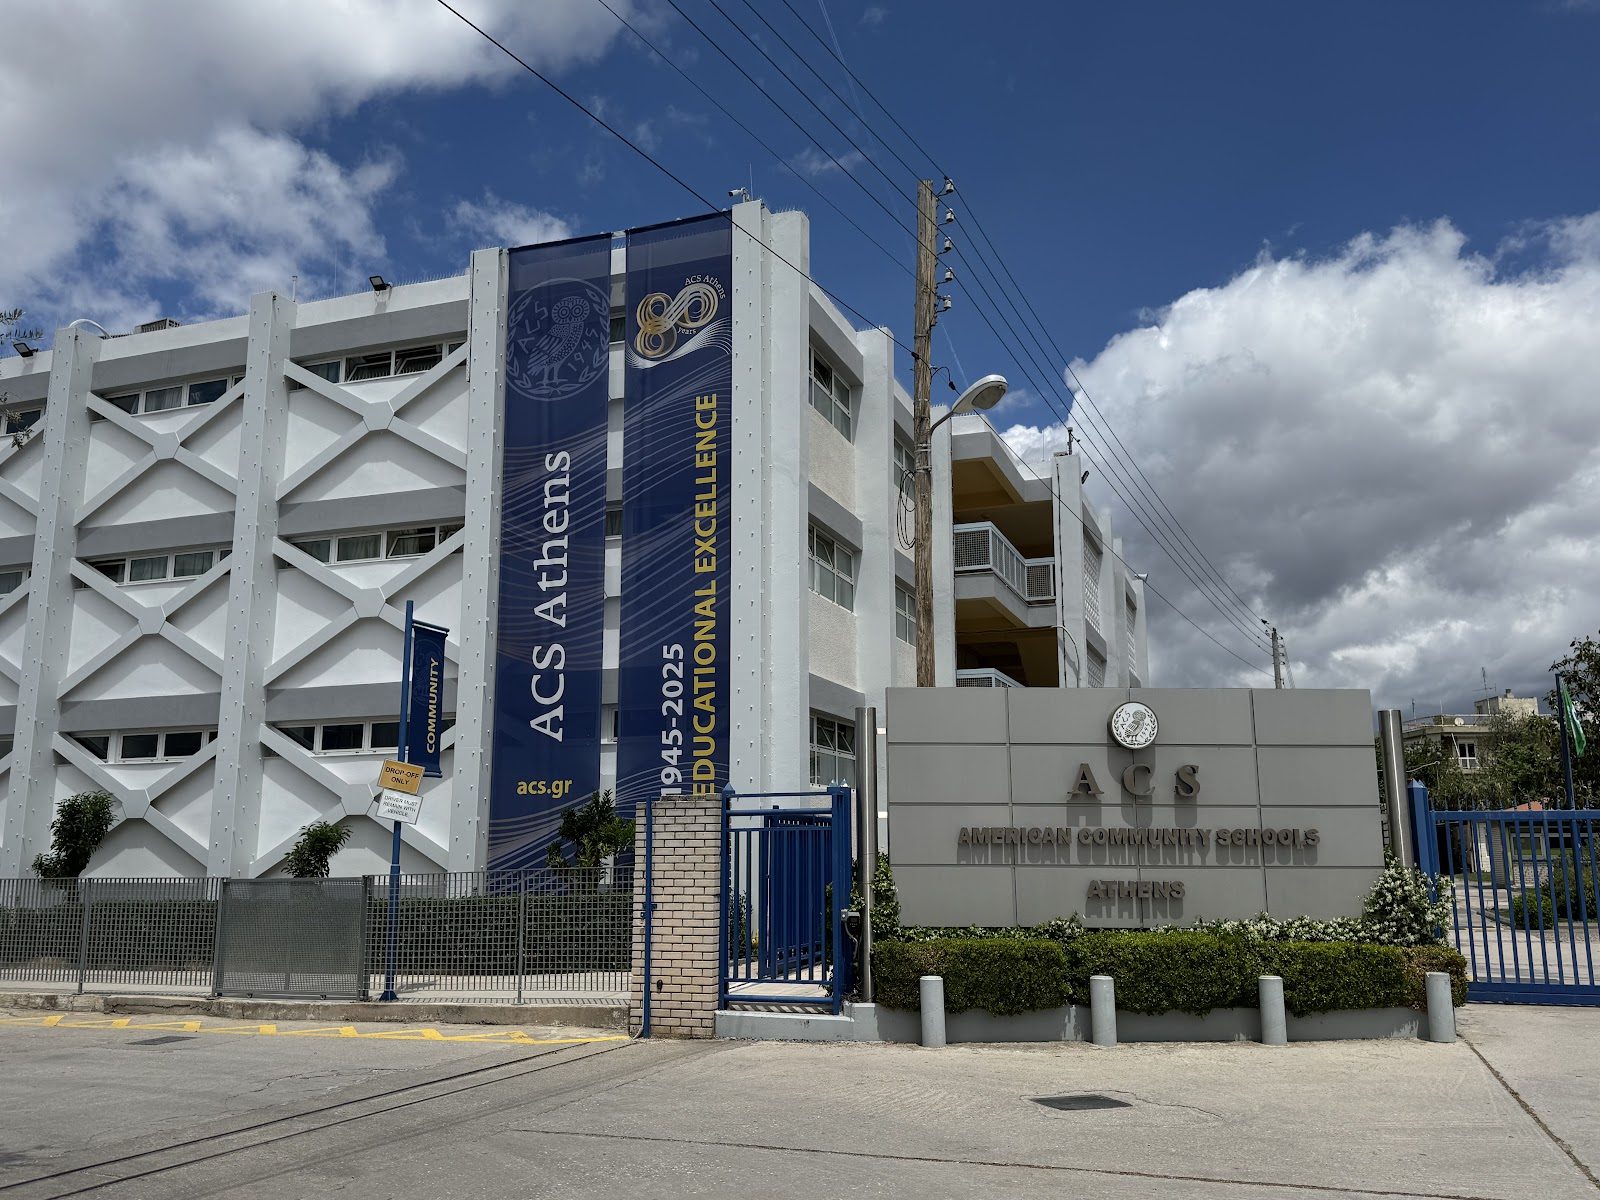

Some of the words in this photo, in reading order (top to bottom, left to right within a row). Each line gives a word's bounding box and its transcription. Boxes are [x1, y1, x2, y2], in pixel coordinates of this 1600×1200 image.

[684, 274, 702, 286] ACS
[703, 274, 726, 299] Athens
[518, 301, 549, 352] ACS
[677, 326, 697, 335] years
[567, 327, 599, 372] 1945
[694, 393, 717, 573] EXCELLENCE
[533, 451, 571, 628] Athens
[427, 657, 439, 754] COMMUNITY
[529, 643, 566, 742] ACS
[692, 580, 717, 796] EDUCATIONAL
[660, 643, 684, 796] 1945-2025
[385, 766, 420, 779] DROP-OFF
[391, 776, 410, 785] ONLY
[516, 779, 573, 799] acs.gr
[387, 808, 409, 817] VEHICLE
[957, 826, 1072, 846] AMERICAN
[1077, 827, 1211, 847] COMMUNITY
[1215, 828, 1321, 848] SCHOOLS
[1086, 879, 1186, 900] ATHENS
